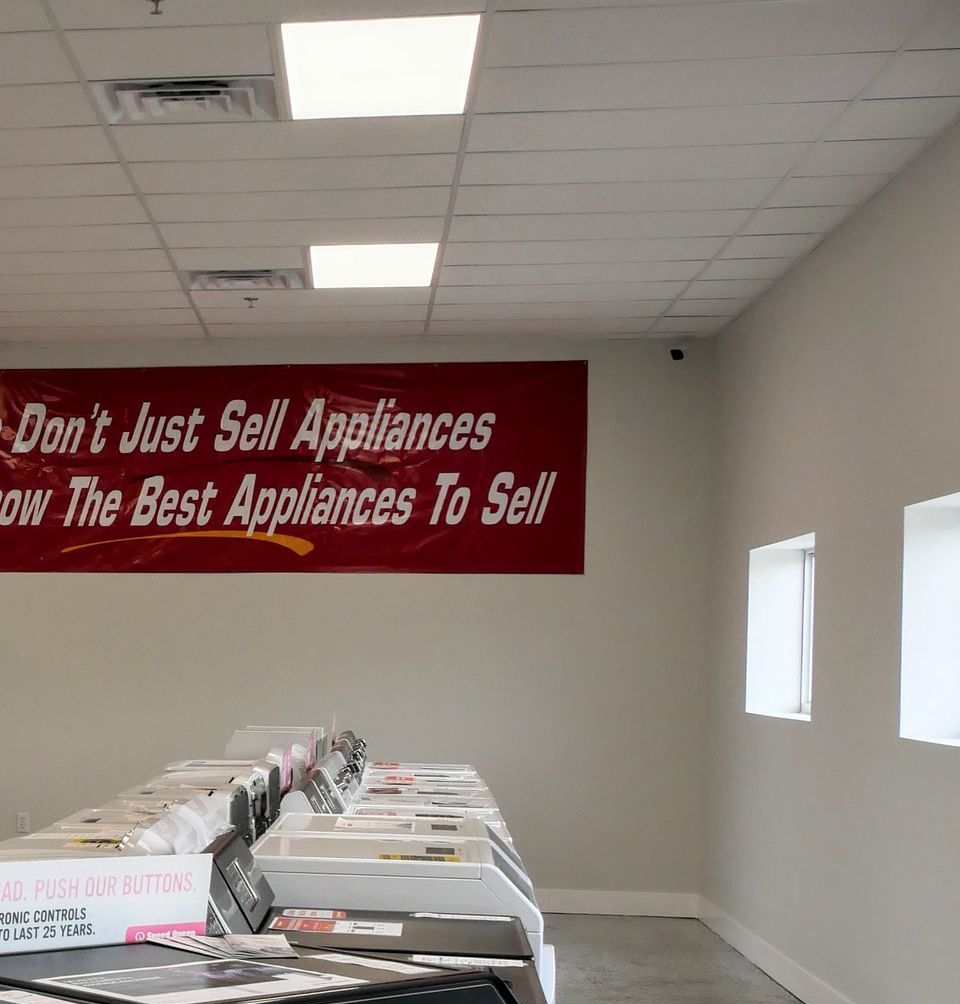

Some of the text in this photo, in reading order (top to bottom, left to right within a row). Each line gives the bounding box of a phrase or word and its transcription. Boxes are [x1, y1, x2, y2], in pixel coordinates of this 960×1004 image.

[12, 402, 113, 454] Don't
[119, 402, 205, 454] Just
[214, 397, 290, 452] Sell
[290, 397, 496, 463] Appliances
[63, 475, 122, 527] The
[130, 474, 219, 527] Best
[222, 473, 417, 537] Appliances
[429, 472, 472, 525] To
[481, 471, 557, 525] Sell
[34, 876, 79, 901] PUSH
[85, 874, 117, 898] OUR
[122, 871, 197, 896] BUTTONS.
[33, 907, 87, 924] CONTROLS
[13, 926, 40, 942] LAST
[42, 925, 57, 940] 25
[60, 923, 97, 939] YEARS.
